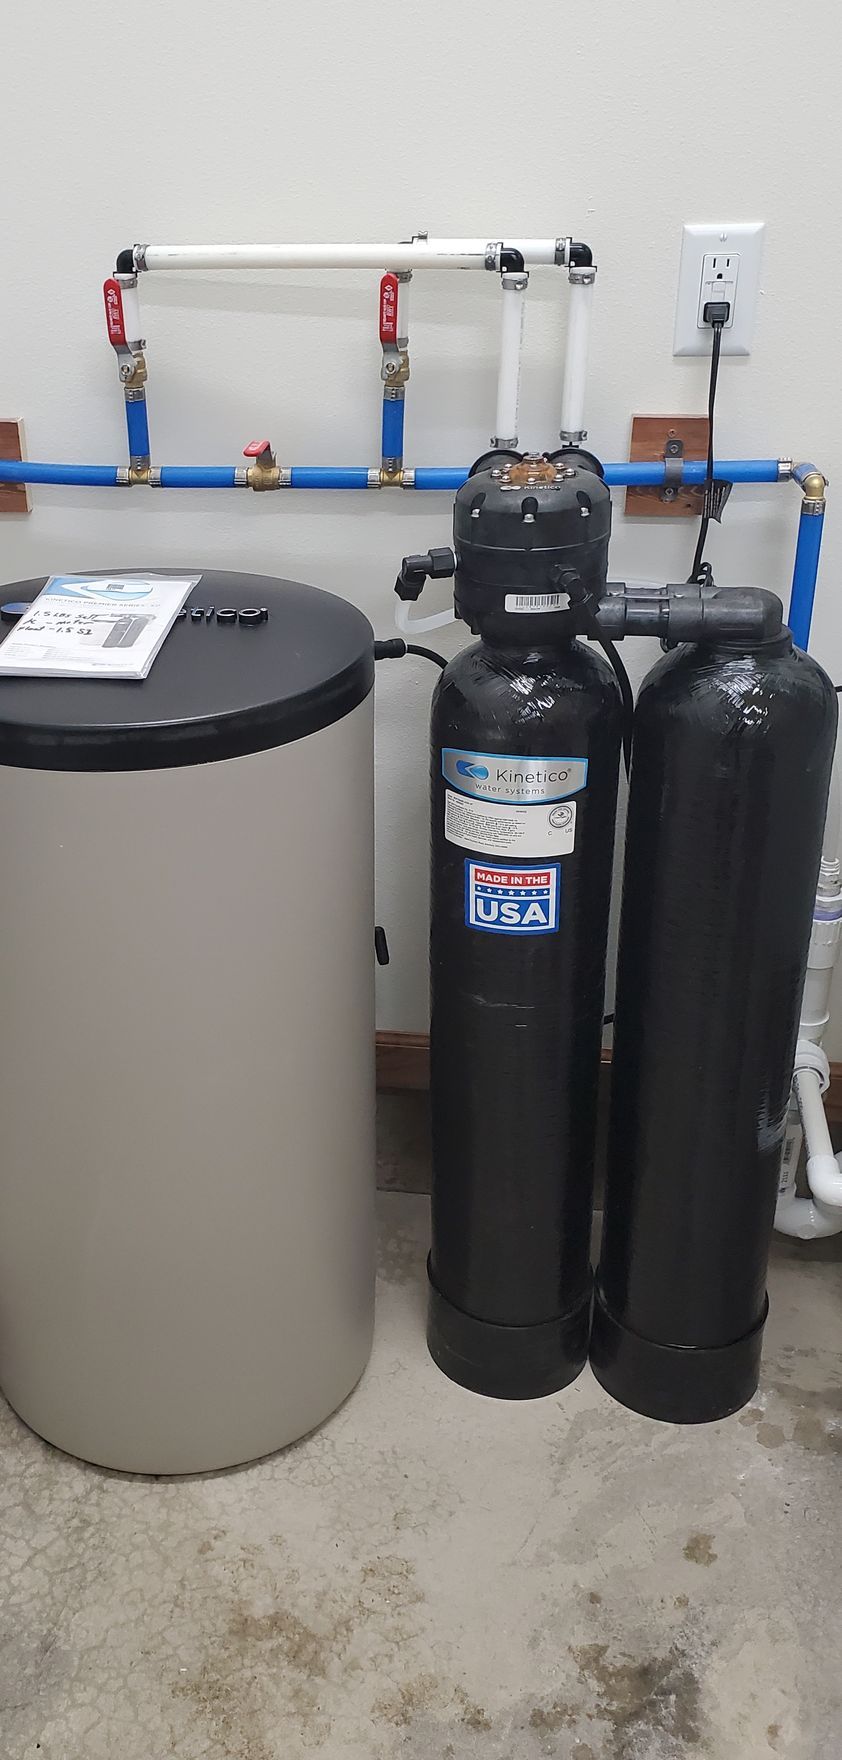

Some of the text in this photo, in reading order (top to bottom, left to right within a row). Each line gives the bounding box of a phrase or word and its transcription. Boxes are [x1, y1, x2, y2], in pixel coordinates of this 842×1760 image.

[496, 769, 568, 783] Kinetico
[475, 783, 545, 796] water systems
[477, 872, 548, 884] MADE IN THE
[476, 898, 548, 925] USA
